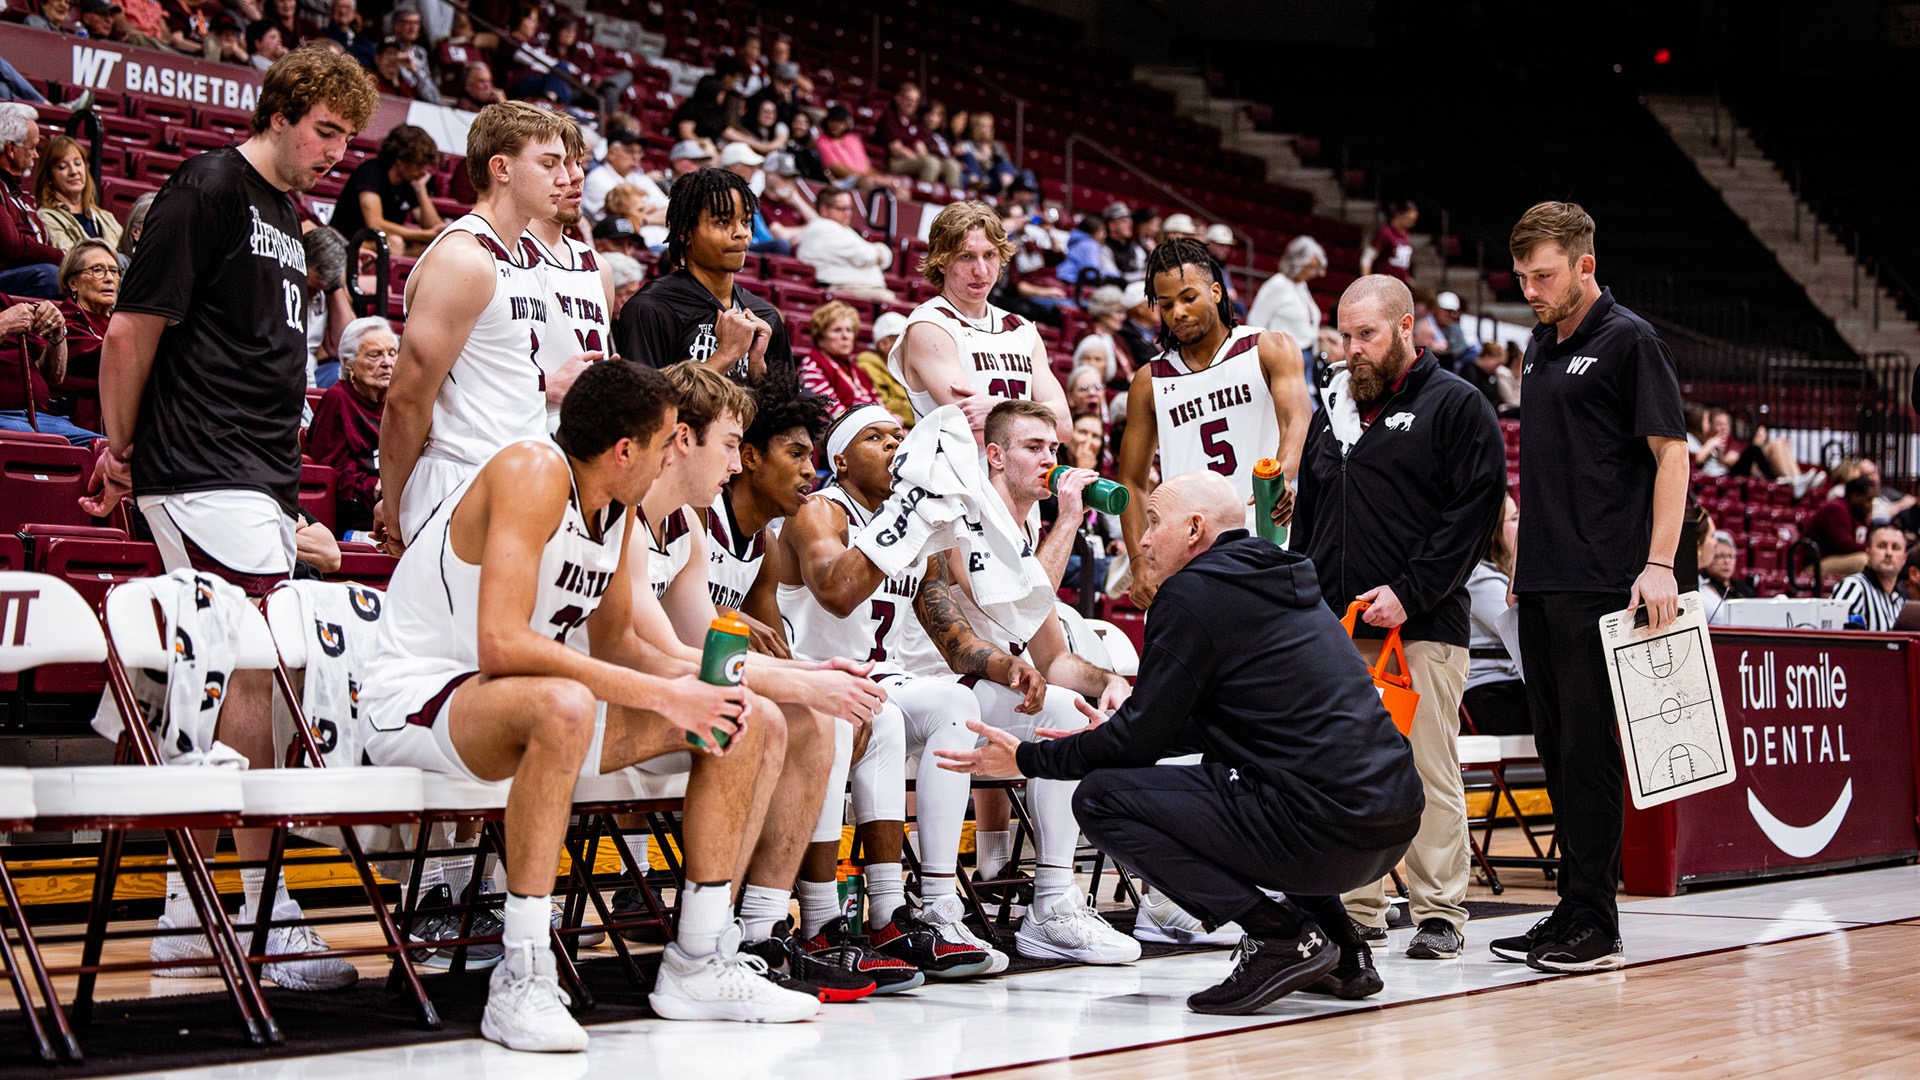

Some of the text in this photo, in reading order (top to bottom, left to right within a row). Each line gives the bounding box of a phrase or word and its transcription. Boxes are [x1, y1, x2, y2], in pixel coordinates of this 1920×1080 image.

[72, 44, 262, 111] WT BASKETBA
[283, 279, 304, 333] 12
[972, 352, 1033, 375] WEST TEXAS
[1566, 356, 1599, 376] WT
[1169, 383, 1252, 428] WEST TEXAS
[1200, 416, 1238, 477] 5
[869, 599, 896, 662] 7
[1738, 650, 1847, 710] full smile
[1743, 724, 1851, 767] DENTAL
